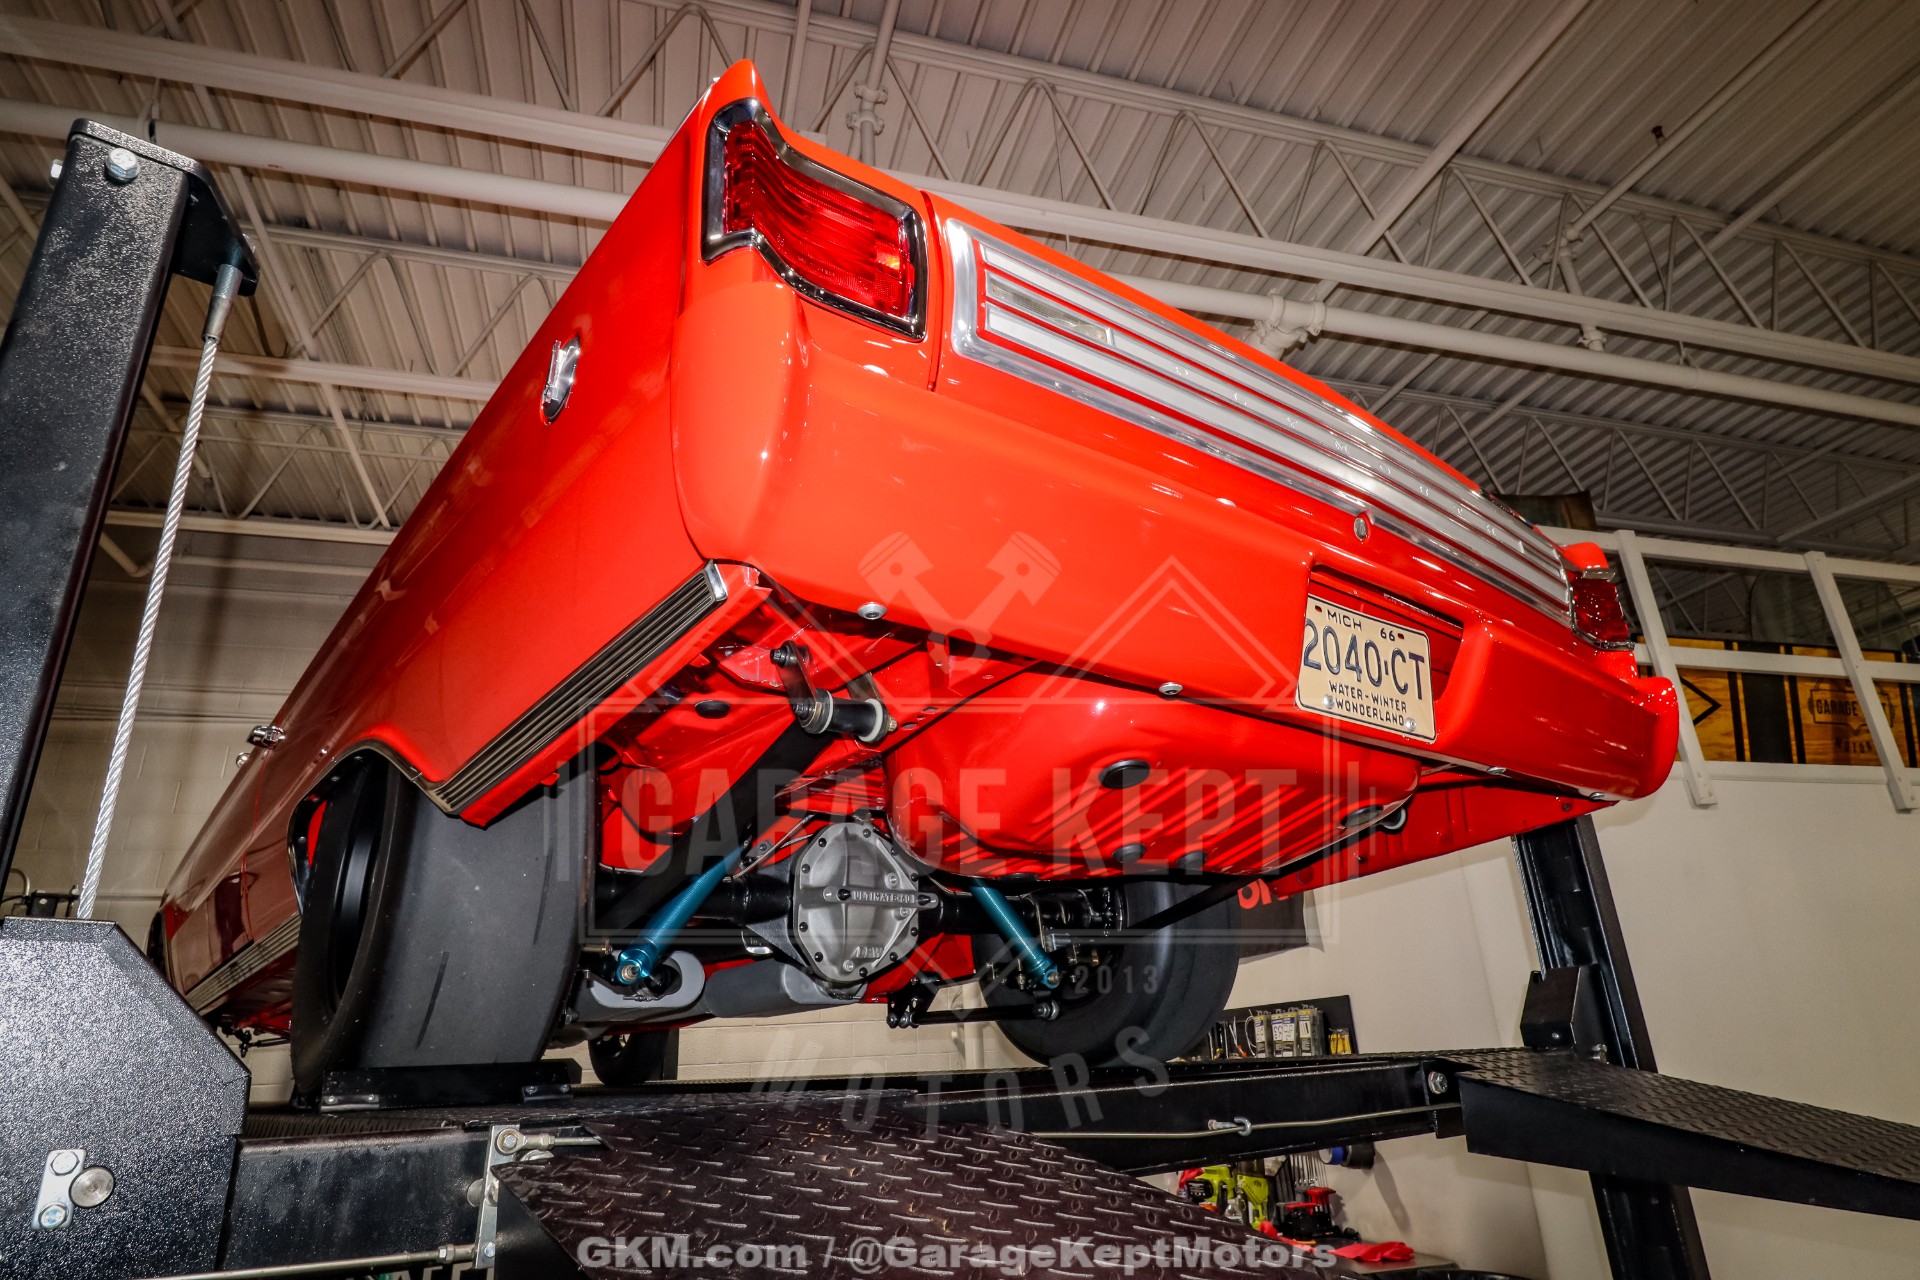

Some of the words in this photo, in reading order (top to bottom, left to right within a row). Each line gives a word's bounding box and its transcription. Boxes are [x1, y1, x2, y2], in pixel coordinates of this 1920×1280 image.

[1327, 609, 1362, 631] MICH
[1380, 627, 1396, 642] 66
[1335, 697, 1405, 727] WONDERLAND
[1816, 698, 1858, 717] GARAGE
